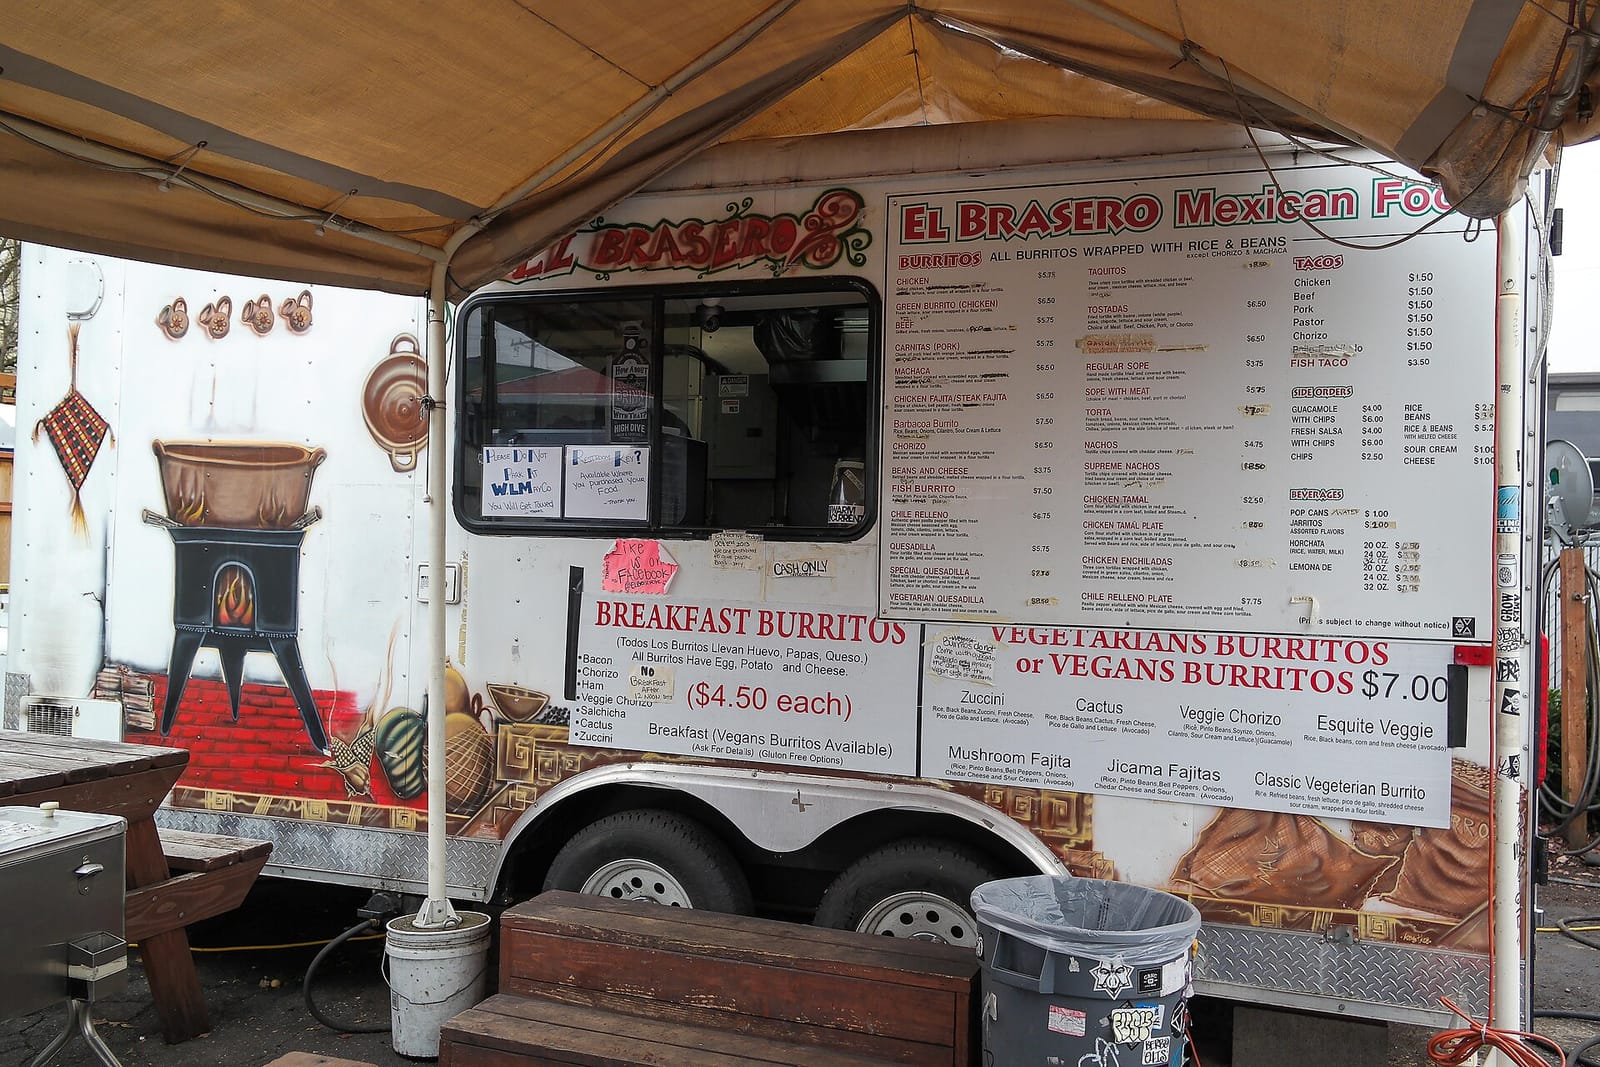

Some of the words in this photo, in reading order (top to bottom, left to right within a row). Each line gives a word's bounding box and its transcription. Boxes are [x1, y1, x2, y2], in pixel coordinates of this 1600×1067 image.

[902, 203, 949, 244] EL
[956, 194, 1162, 242] BRASERO
[1175, 184, 1358, 229] Mexican
[1372, 176, 1456, 219] Foo
[512, 234, 577, 279] L
[596, 218, 799, 270] BRASERO
[899, 252, 982, 270] BURRITOS
[990, 249, 1011, 262] ALL
[1017, 248, 1078, 260] BURRITOS
[1083, 244, 1144, 257] WRAPPED
[1151, 242, 1182, 253] WITH
[1189, 240, 1218, 250] RICE
[1225, 239, 1234, 249] &
[1241, 237, 1286, 248] BEANS
[1293, 255, 1344, 270] TACOS
[1088, 267, 1126, 276] TAQUITOS
[896, 277, 929, 286] CHICKEN
[1294, 278, 1331, 287] Chicken
[1409, 273, 1433, 282] $1.50
[1294, 292, 1315, 300] Beef
[1408, 287, 1433, 296] $1.50
[896, 302, 921, 310] GREEN
[924, 301, 955, 310] BURRITO
[959, 300, 998, 309] (CHICKEN)
[1088, 305, 1128, 313] TOSTADAS
[1293, 305, 1314, 314] Pork
[1293, 317, 1324, 326] Pastor
[1293, 332, 1327, 340] Chorizo
[933, 342, 960, 351] (PORK)
[1291, 359, 1314, 367] FISH
[1318, 359, 1348, 367] TACO
[1407, 358, 1430, 366] $3.50
[1292, 387, 1314, 398] SIDE
[1314, 386, 1353, 398] ORDERS
[1405, 413, 1430, 421] BEANS
[894, 420, 931, 428] Barbacoa
[1290, 489, 1344, 501] BEVERAGES
[890, 543, 935, 551] QUESADILLA
[1082, 556, 1118, 564] CHICKEN
[774, 561, 800, 576] CASH
[802, 560, 827, 576] ONLY
[595, 601, 750, 636] BREAKFAST
[757, 610, 906, 645] BURRITOS
[1326, 618, 1352, 627] subject
[1365, 620, 1392, 628] change
[1395, 620, 1421, 628] without
[616, 636, 648, 650] (Todos
[651, 639, 668, 650] Los
[672, 640, 708, 652] Burritos
[711, 643, 744, 654] Llevan
[747, 646, 780, 658] Huevo,
[786, 648, 822, 662] Papas,
[826, 650, 868, 665] Queso.)
[1214, 636, 1389, 666] BURRITOS
[583, 655, 612, 665] Bacon
[632, 652, 643, 661] All
[647, 652, 683, 664] Burritos
[687, 655, 711, 666] Have
[715, 657, 737, 670] Egg,
[741, 659, 772, 671] Potato
[783, 662, 801, 673] and
[805, 663, 848, 677] Cheese.
[583, 667, 618, 678] Chorizo
[1016, 658, 1043, 674] or
[1049, 654, 1174, 682] VEGANS
[1182, 661, 1354, 695] BURRITOS
[1362, 670, 1448, 702] $7.00
[582, 680, 603, 690] Ham
[582, 695, 612, 706] Veggie
[687, 682, 768, 710] ($4.50
[777, 691, 852, 722] each)
[961, 691, 1004, 705] Zuccini
[581, 706, 626, 718] Salchicha
[1076, 699, 1123, 714] Cactus
[1180, 706, 1224, 724] Veggie
[1229, 708, 1281, 726] Chorizo
[580, 719, 613, 730] Cactus
[1318, 715, 1374, 734] Esquite
[1380, 720, 1433, 742] Veggie
[579, 731, 613, 743] Zuccini
[649, 722, 708, 740] Breakfast
[712, 727, 765, 746] (Vegans
[770, 734, 821, 750] Burritos
[825, 738, 893, 759] Available)
[692, 743, 708, 754] (Ask
[711, 745, 723, 754] For
[726, 746, 754, 757] Details)
[790, 752, 807, 761] Free
[810, 754, 843, 766] Options)
[949, 746, 1025, 765] Mushroom
[1031, 753, 1071, 770] Fajita
[1108, 760, 1162, 776] Jicama
[1168, 764, 1221, 782] Fajitas
[1254, 772, 1300, 789] Classic
[1305, 776, 1376, 796] Vegeterian
[1381, 783, 1425, 800] Burrito
